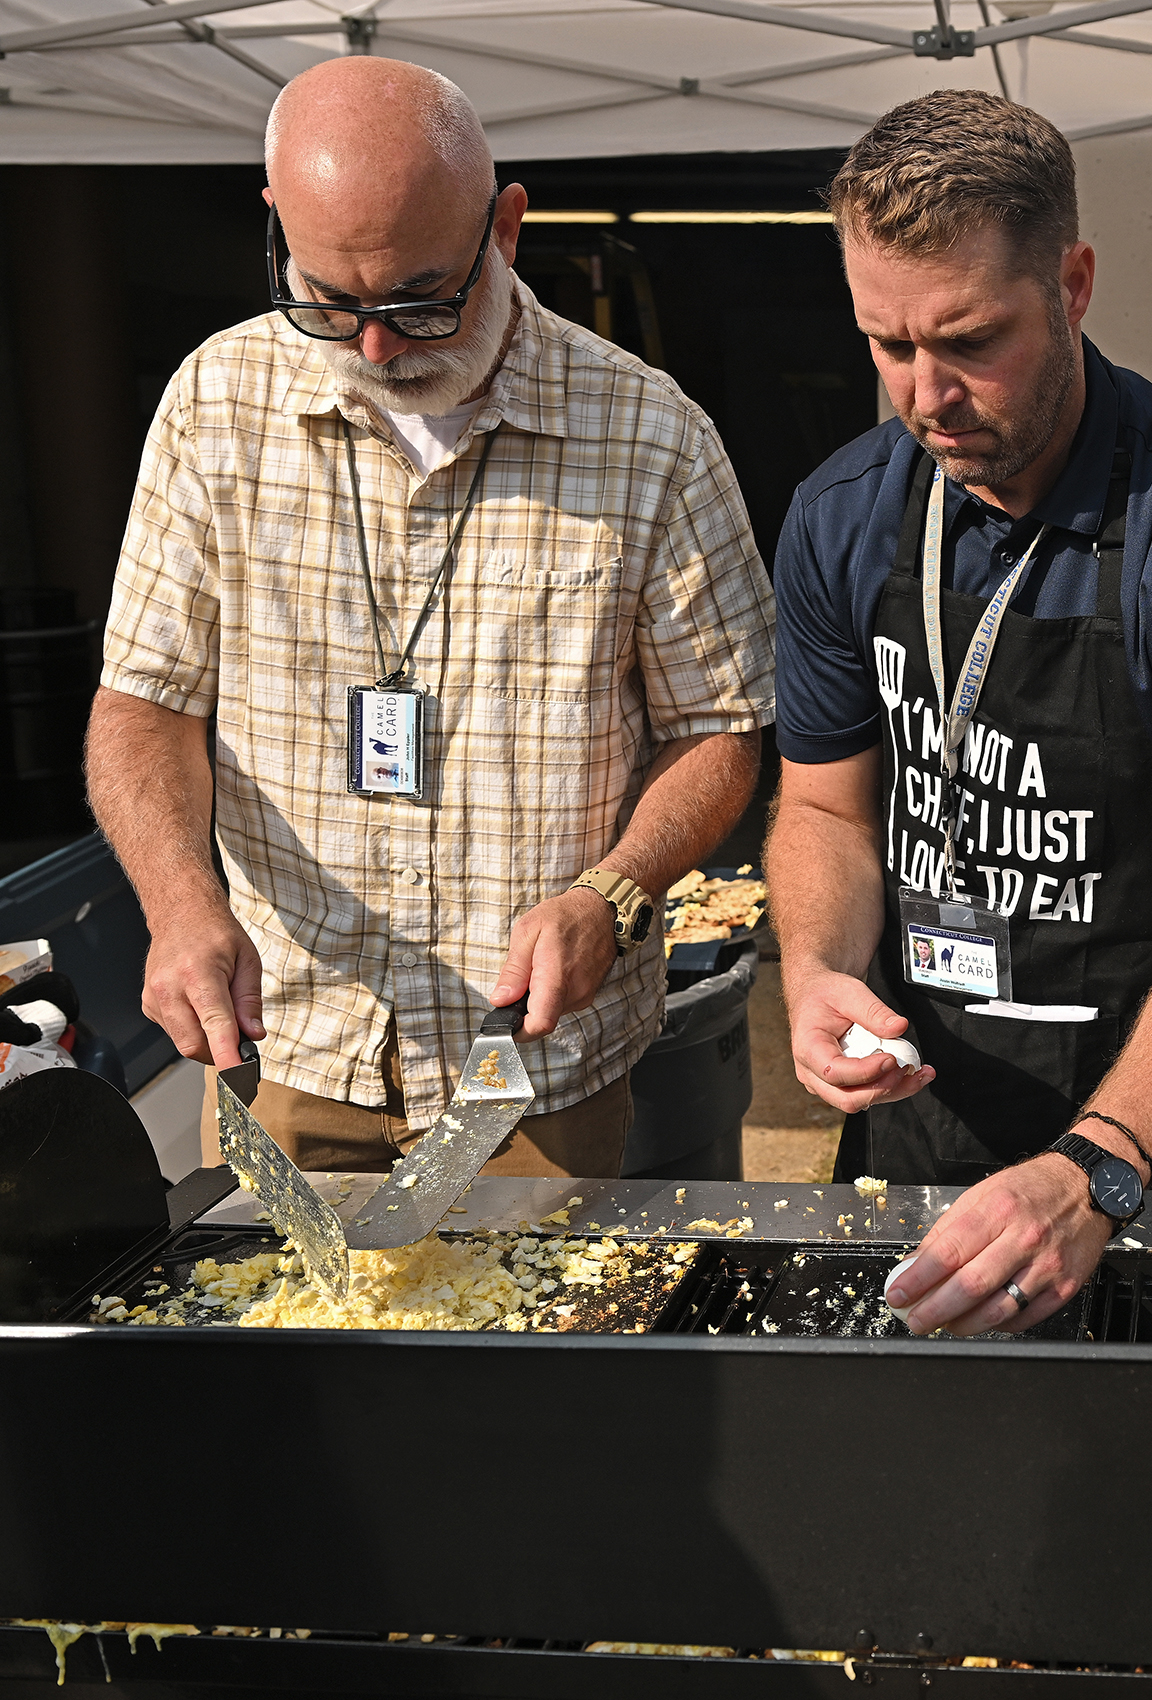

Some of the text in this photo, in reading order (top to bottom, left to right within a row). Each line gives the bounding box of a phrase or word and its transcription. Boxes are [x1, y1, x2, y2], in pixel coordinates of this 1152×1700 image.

[956, 640, 988, 718] COLLEGE
[386, 696, 397, 737] CARD
[902, 696, 1047, 798] I'M NOT A
[996, 806, 1094, 863] JUST
[976, 865, 1024, 918] TO
[1028, 872, 1102, 924] EAT
[958, 953, 992, 967] CAMEL
[958, 963, 994, 978] CARD
